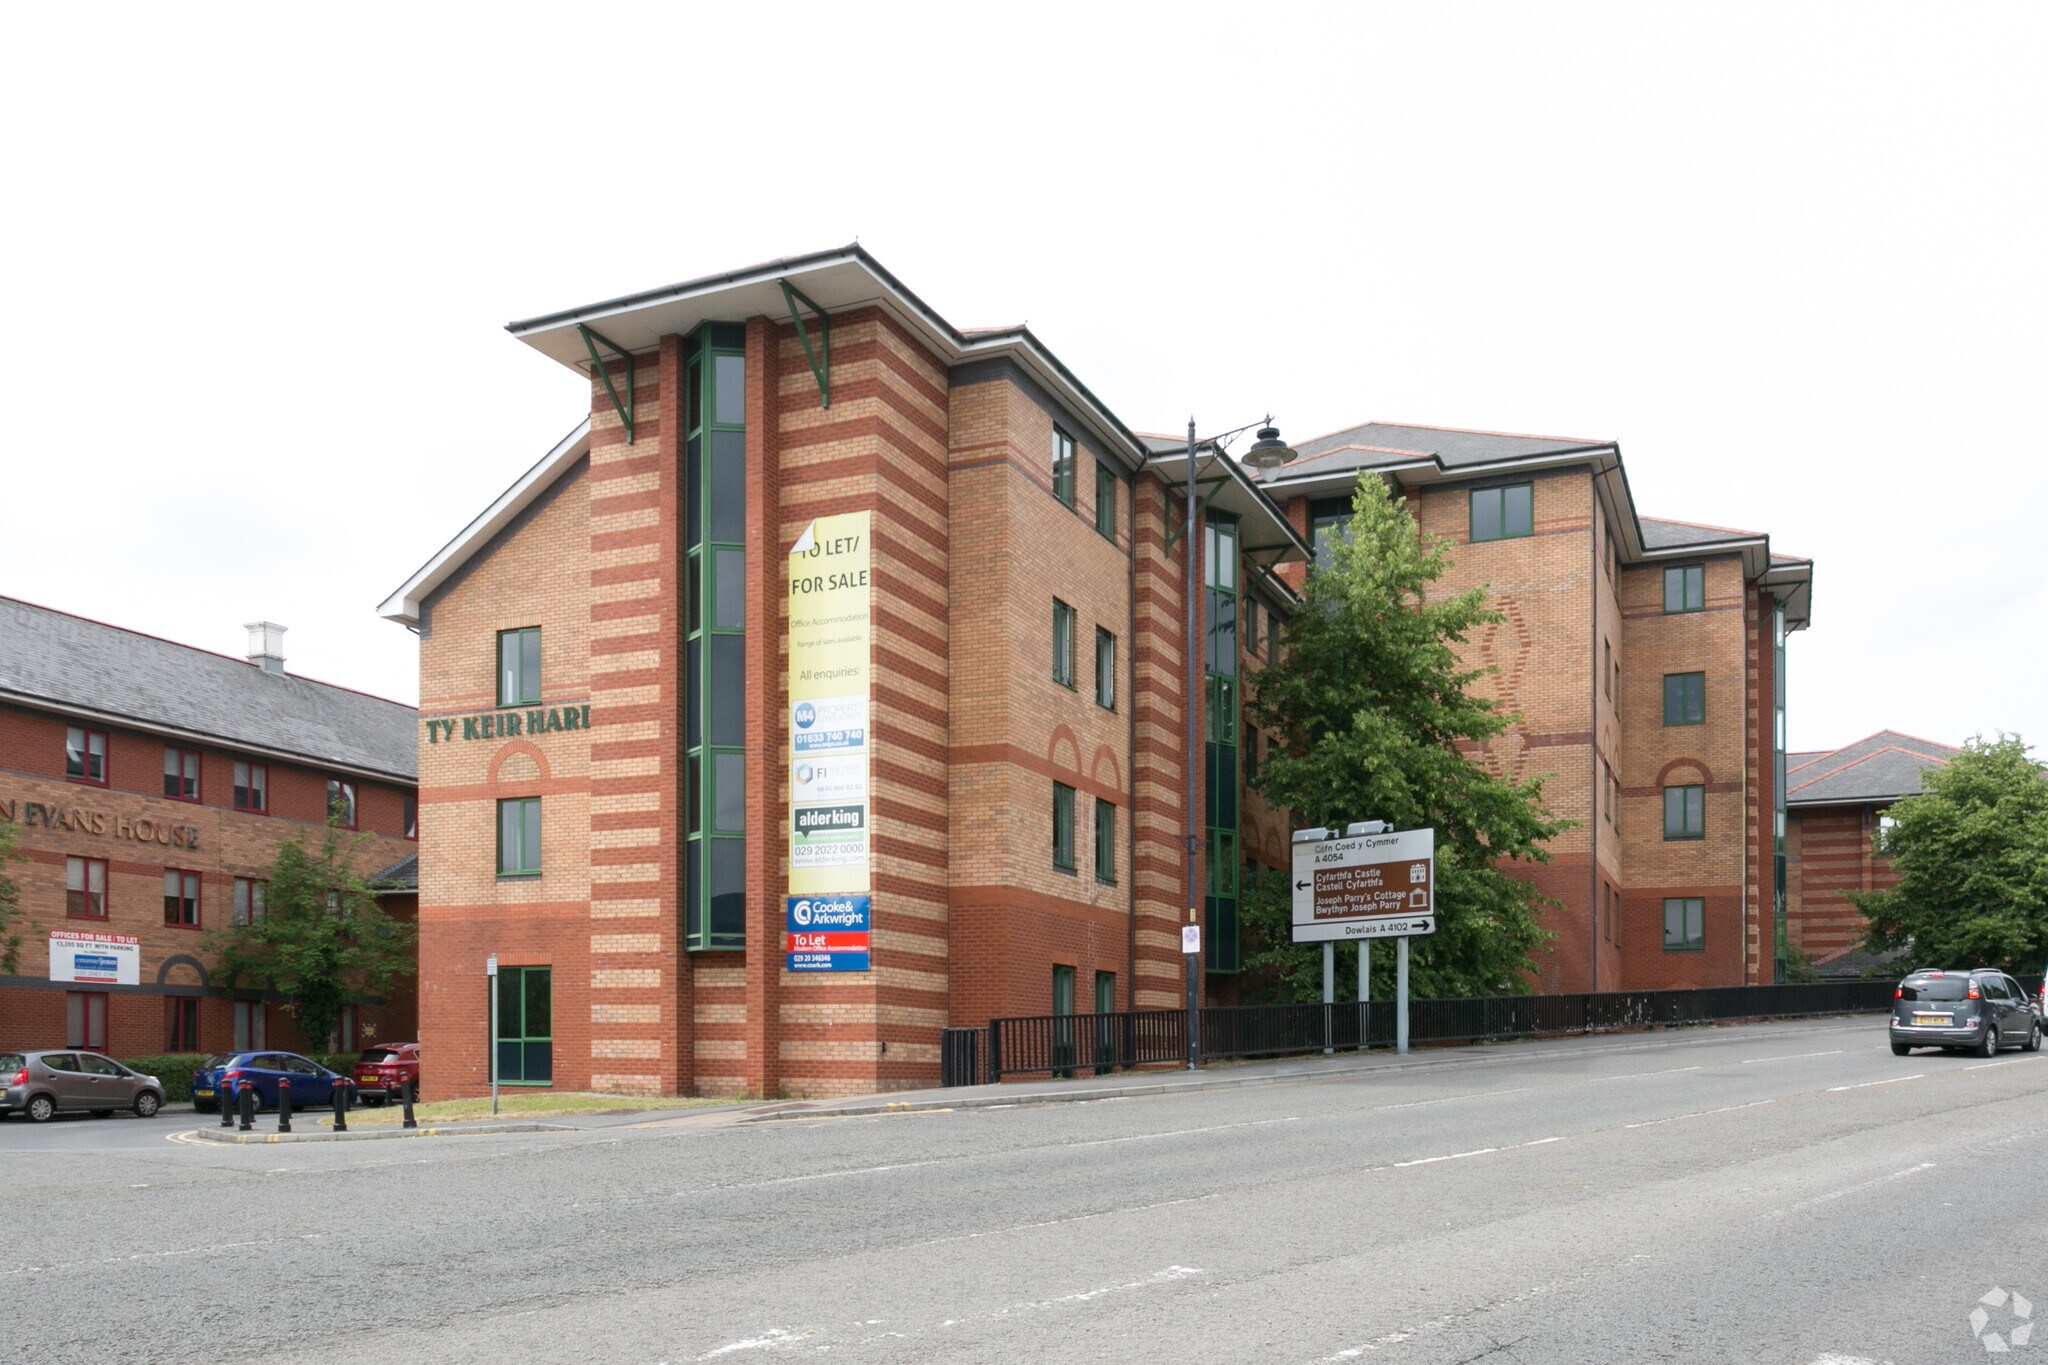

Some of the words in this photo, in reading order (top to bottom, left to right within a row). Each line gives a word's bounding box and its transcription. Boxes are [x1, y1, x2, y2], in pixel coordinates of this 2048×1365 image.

[826, 536, 860, 556] LET/
[792, 576, 824, 595] FOR
[828, 570, 868, 591] SALE
[791, 618, 810, 629] Office
[811, 612, 869, 627] Accommodation
[797, 639, 815, 648] Range
[816, 638, 822, 646] of
[823, 637, 836, 645] sizes
[837, 634, 862, 644] available
[800, 670, 812, 681] All
[814, 666, 860, 682] enquiries:
[796, 710, 814, 722] M4
[426, 718, 456, 743] TY
[463, 712, 522, 740] KEIR
[796, 733, 824, 744] 01633
[826, 731, 843, 741] 740
[845, 729, 862, 739] 740
[817, 767, 827, 778] FI
[25, 802, 105, 835] EVANS
[116, 815, 199, 849] HOUSE
[795, 846, 812, 856] 029
[815, 845, 838, 855] 2022
[840, 843, 864, 853] 0000
[1335, 841, 1356, 851] Coed
[1358, 842, 1363, 850] y
[1366, 837, 1399, 848] Cymmer
[795, 856, 864, 864] www.alderking.com
[1315, 855, 1321, 863] A
[1322, 853, 1343, 862] 4054
[1316, 870, 1352, 883] Cyfarthfa
[1355, 868, 1381, 878] Castle
[1316, 882, 1343, 892] Castell
[1346, 878, 1383, 890] Cyfarthfa
[1316, 895, 1343, 906] Joseph
[1344, 893, 1371, 904] Parry's
[1374, 890, 1407, 900] Cottage
[1316, 904, 1348, 915] Bwythyn
[1350, 901, 1377, 912] Joseph
[1380, 900, 1401, 910] Parry
[813, 913, 863, 926] Arkwright
[1345, 925, 1376, 935] Dowlais
[1380, 924, 1386, 932] A
[1387, 923, 1408, 931] 4102
[51, 931, 79, 940] OFFICES
[80, 933, 94, 941] FOR
[95, 934, 112, 942] SALE
[793, 934, 806, 945] To
[809, 934, 826, 945] Let
